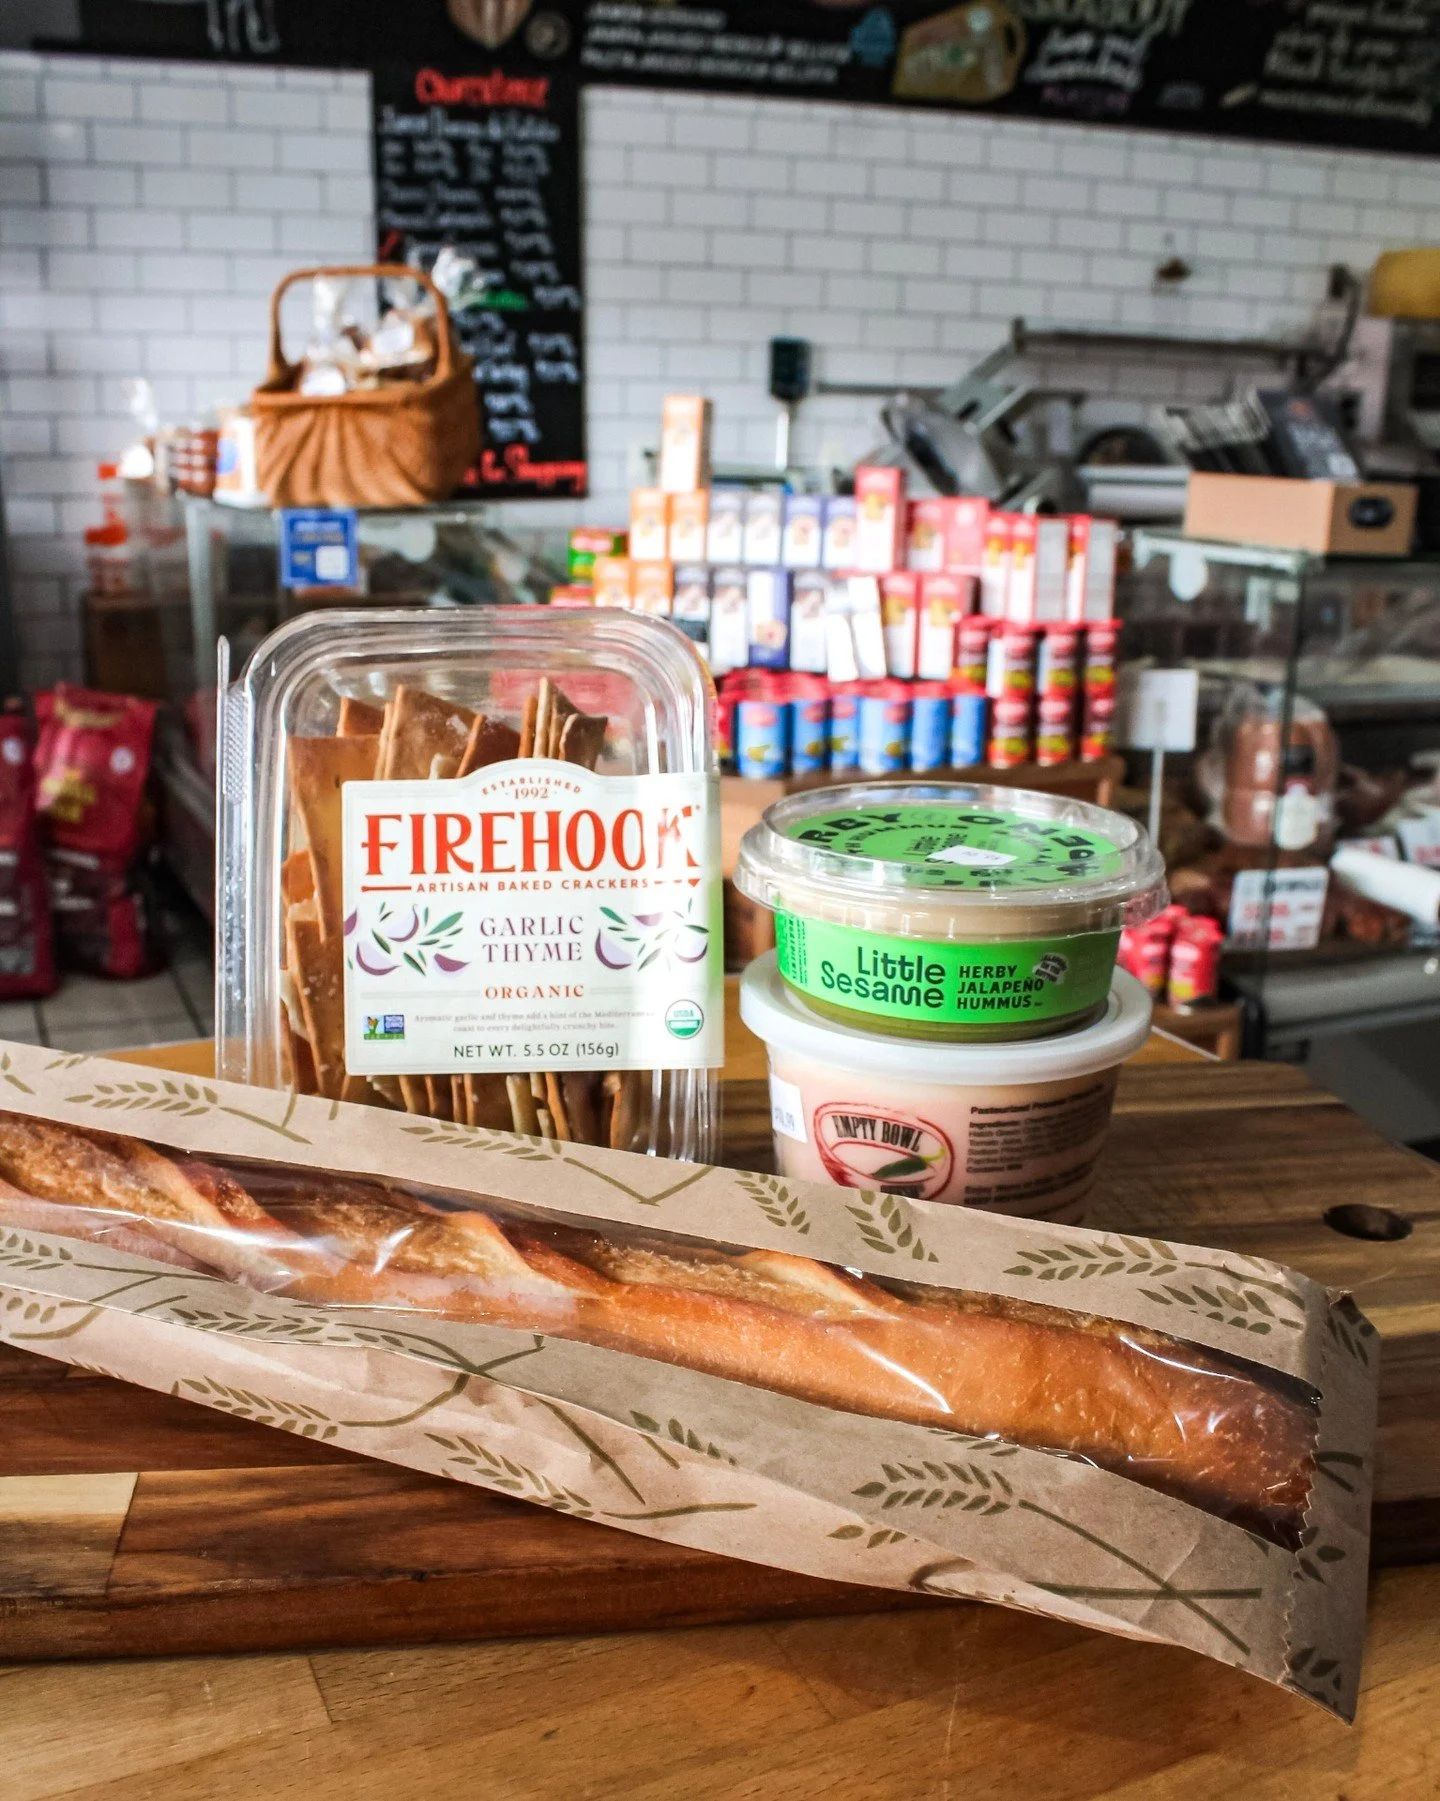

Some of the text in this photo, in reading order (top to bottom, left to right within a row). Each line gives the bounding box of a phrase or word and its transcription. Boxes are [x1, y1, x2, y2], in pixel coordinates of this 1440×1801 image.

[482, 777, 580, 795] ESTABLISHED
[514, 787, 549, 799] 1992
[361, 805, 701, 876] FIREHOOK
[417, 878, 649, 892] ARTISAN BAKED CRACKERS
[480, 916, 584, 938] GARLIC
[482, 942, 583, 963] THYME
[857, 946, 946, 985] Little
[959, 965, 1018, 978] HERBY
[485, 985, 585, 1000] ORGANIC
[821, 960, 945, 1009] Sesame
[957, 976, 1045, 995] JALAPEÑO
[957, 995, 1033, 1009] HUMMUS
[454, 1042, 620, 1058] NET WT. 5.5 OZ (156g)
[831, 1115, 877, 1141] EMPTY
[881, 1120, 923, 1153] BOWL
